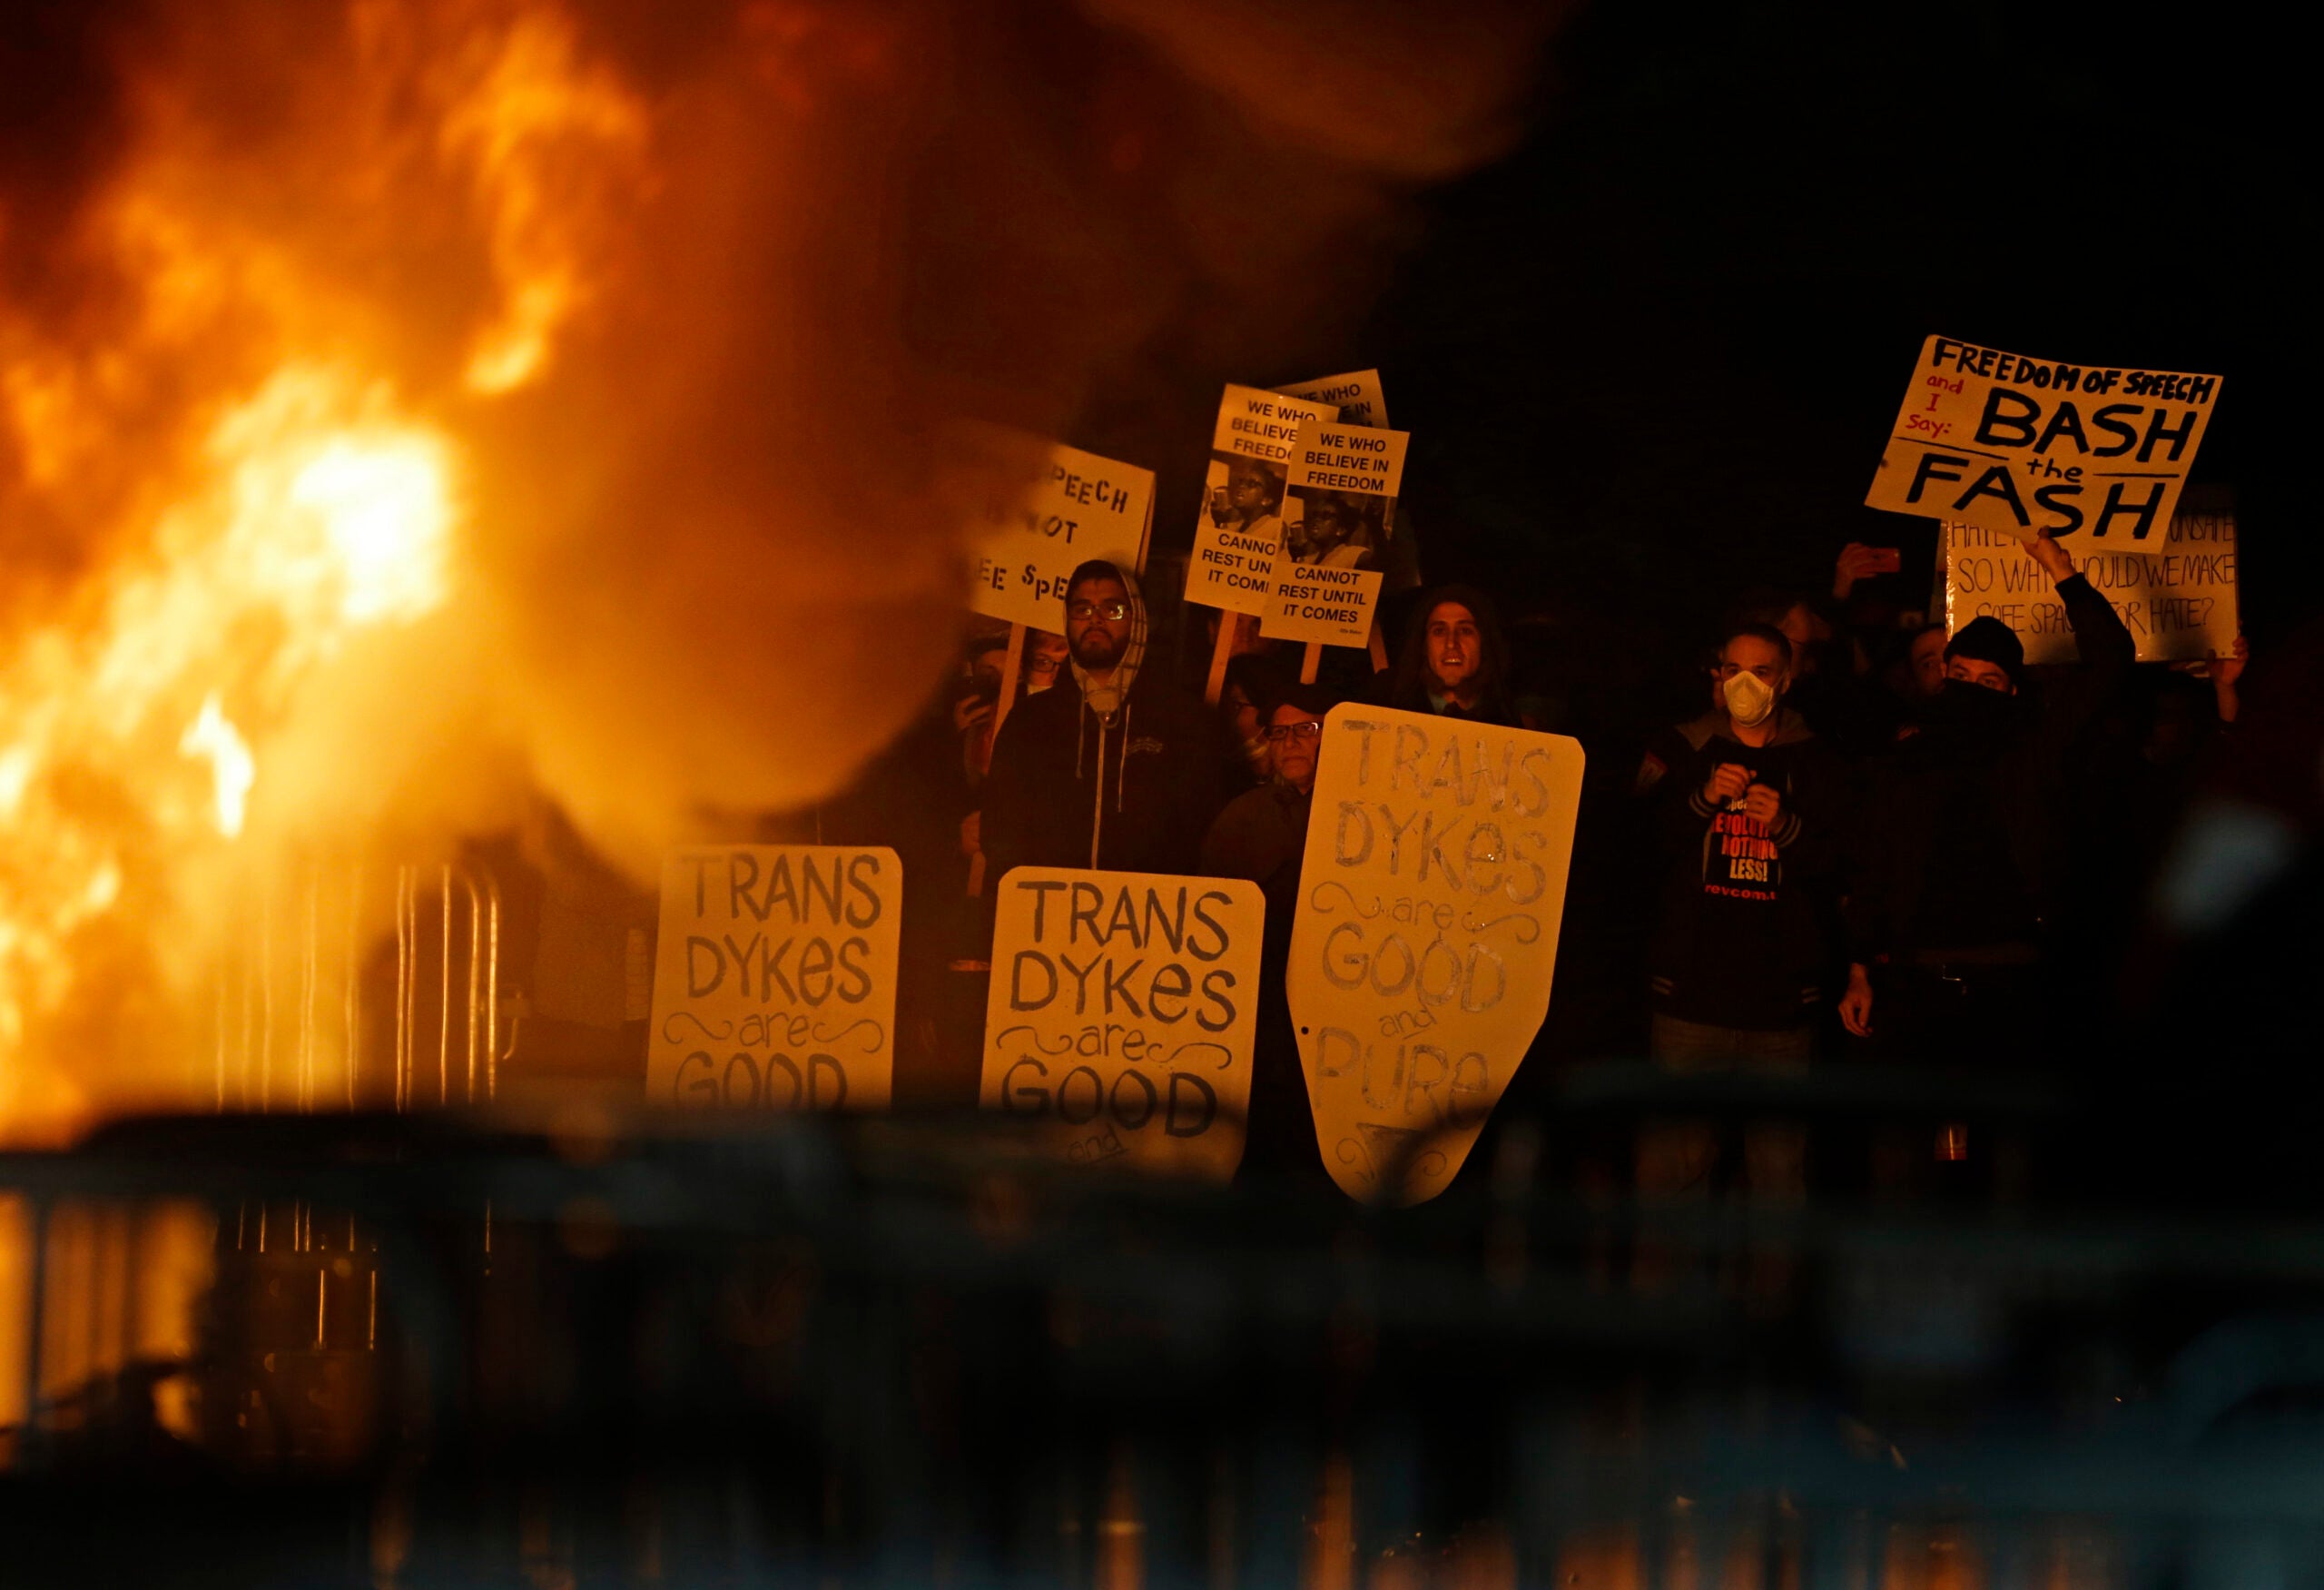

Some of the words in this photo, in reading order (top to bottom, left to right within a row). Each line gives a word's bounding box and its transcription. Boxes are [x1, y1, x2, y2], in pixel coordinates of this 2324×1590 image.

[1926, 375, 1965, 394] and
[1933, 339, 2080, 391] FREEDOM
[2083, 370, 2122, 394] OF
[2122, 371, 2215, 404] SPEECH
[1323, 383, 1361, 401] WHO
[1925, 393, 1942, 412] I
[1248, 400, 1274, 417] WE
[1354, 400, 1372, 416] IN
[1231, 417, 1298, 442] BELIEVE
[1974, 387, 2198, 463] BASH
[1234, 438, 1292, 461] FREED
[1320, 432, 1344, 448] WE
[1349, 436, 1386, 453] WHO
[1305, 450, 1369, 470] BELIEVE
[1373, 459, 1390, 473] IN
[2025, 458, 2083, 483] the
[1051, 465, 1128, 515] PEECH
[1307, 470, 1385, 491] FREEDOM
[1905, 452, 2166, 539] FASH
[1218, 532, 1275, 556] CANNO
[1202, 548, 1245, 568] REST
[980, 557, 1008, 592] EE
[1021, 563, 1068, 601] SPE
[1207, 568, 1224, 583] IT
[1226, 572, 1270, 594] COM
[1295, 566, 1361, 586] CANNOT
[1958, 558, 1994, 594] SO
[2073, 554, 2141, 589] OULD
[2143, 555, 2180, 588] WE
[2181, 553, 2237, 587] MAKE
[1278, 583, 1319, 600] REST
[1323, 589, 1366, 606] UNTIL
[1284, 603, 1299, 617] IT
[1302, 603, 1358, 623] COMES
[2109, 601, 2147, 636] OR
[2149, 596, 2215, 635] HATE?
[1343, 720, 1553, 818] TRANS
[1729, 857, 1768, 883] LESS!
[682, 851, 882, 930] TRANS
[1017, 880, 1234, 963] TRANS
[1392, 896, 1454, 931] are
[1323, 923, 1506, 1014] GOOD
[739, 1011, 811, 1048] are
[1378, 1003, 1438, 1038] and
[1076, 1023, 1146, 1062] are
[675, 1050, 849, 1119] GOOD
[1001, 1056, 1218, 1139] GOOD
